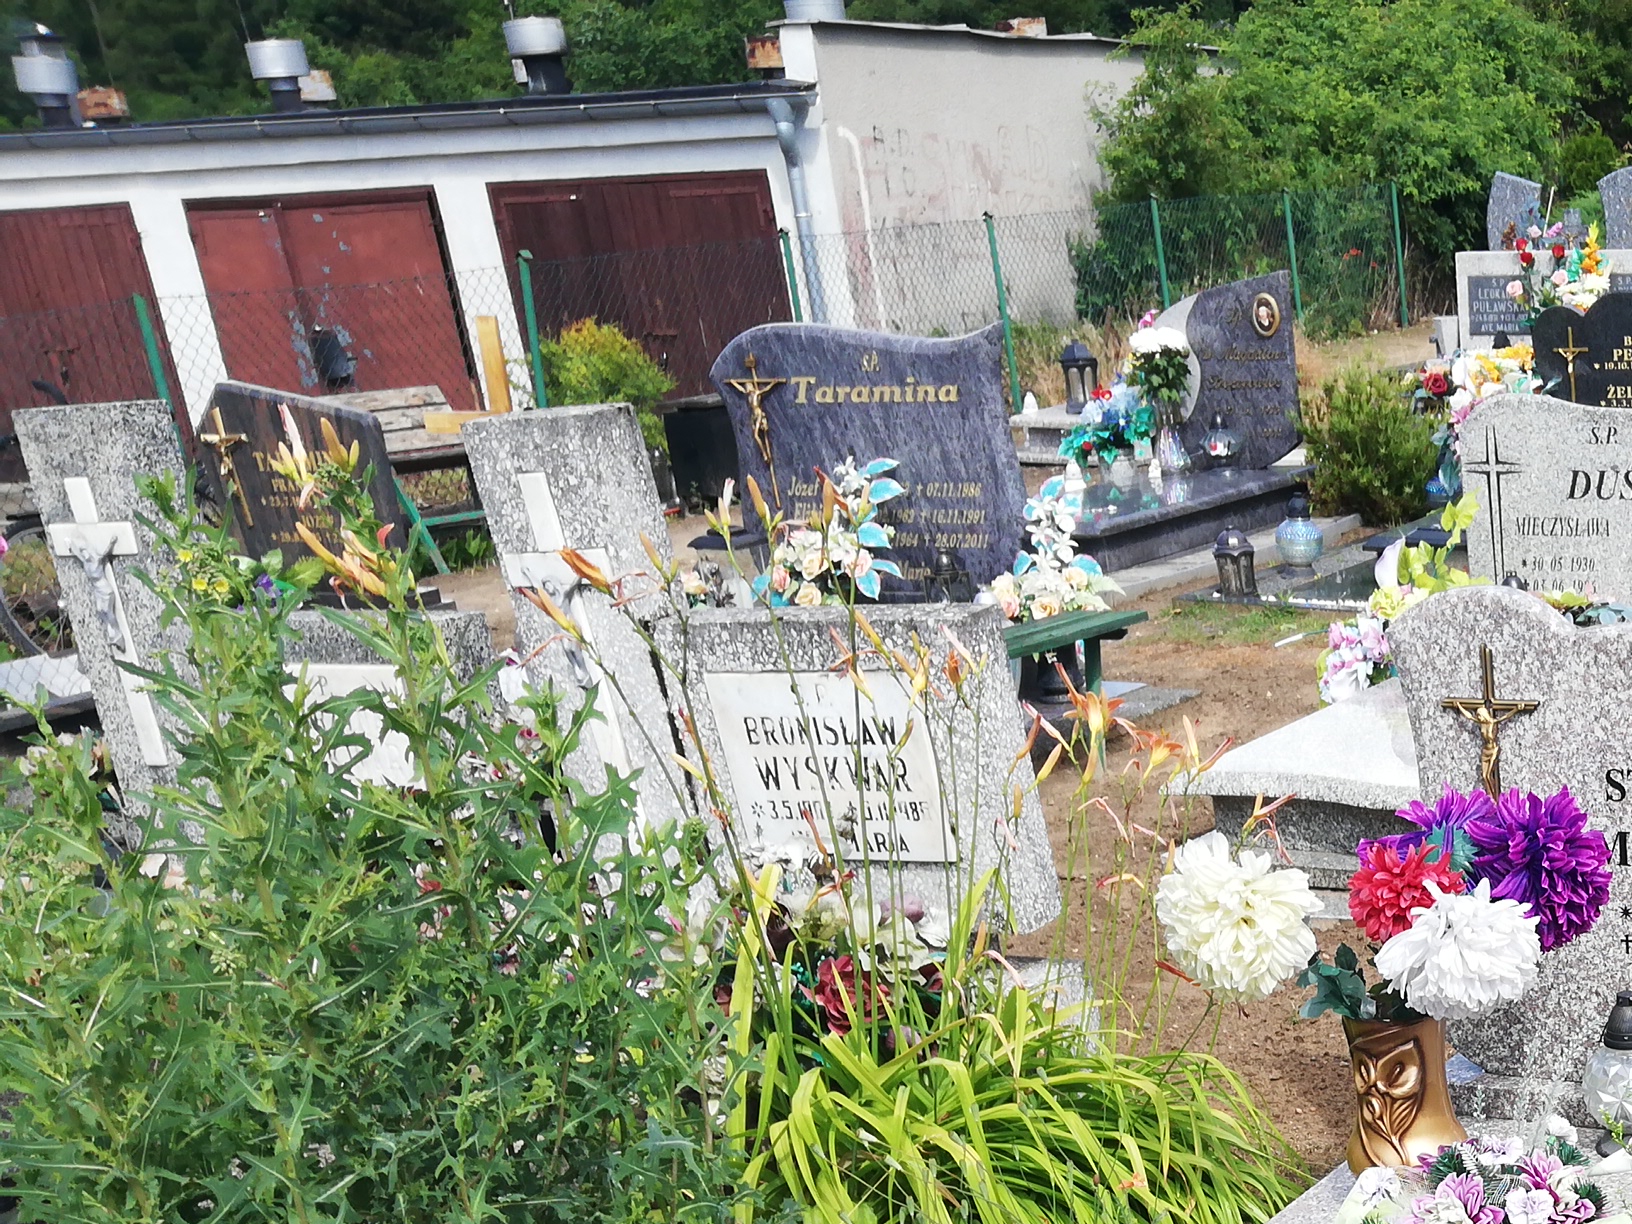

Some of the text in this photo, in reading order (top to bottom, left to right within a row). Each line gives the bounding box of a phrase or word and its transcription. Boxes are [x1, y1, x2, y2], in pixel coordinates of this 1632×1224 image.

[790, 376, 960, 404] Taramina
[926, 481, 983, 499] 07.11.1986
[931, 509, 986, 525] 16.11.1991
[934, 533, 990, 550] 28.07.2011
[1532, 556, 1544, 572] 30
[1570, 557, 1596, 573] 1930
